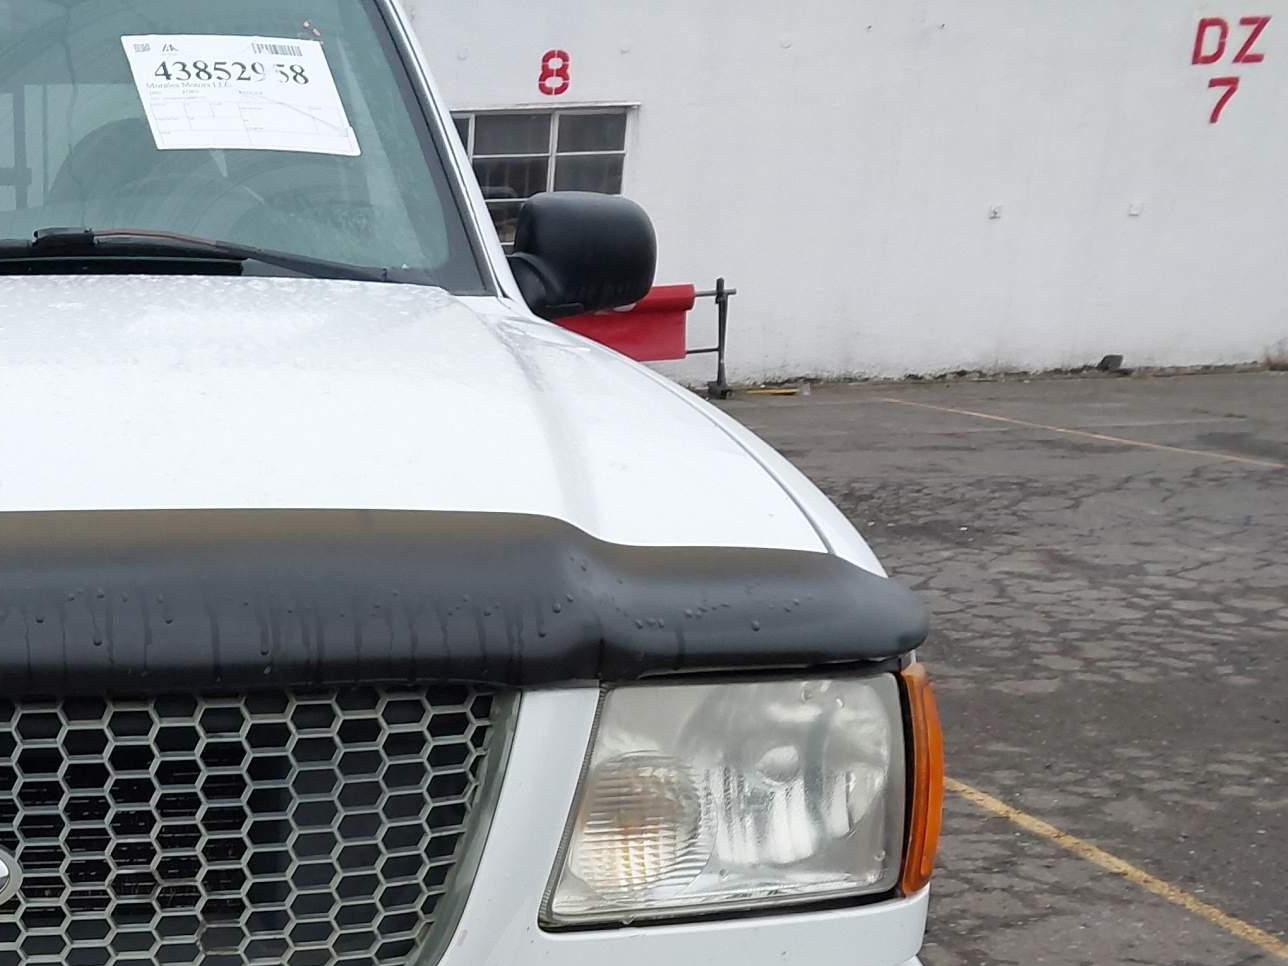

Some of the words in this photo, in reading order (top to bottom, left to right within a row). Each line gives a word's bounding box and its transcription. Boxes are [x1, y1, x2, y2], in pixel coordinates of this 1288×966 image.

[1191, 15, 1272, 65] DZ
[538, 49, 569, 95] 8
[1208, 76, 1239, 123] 7
